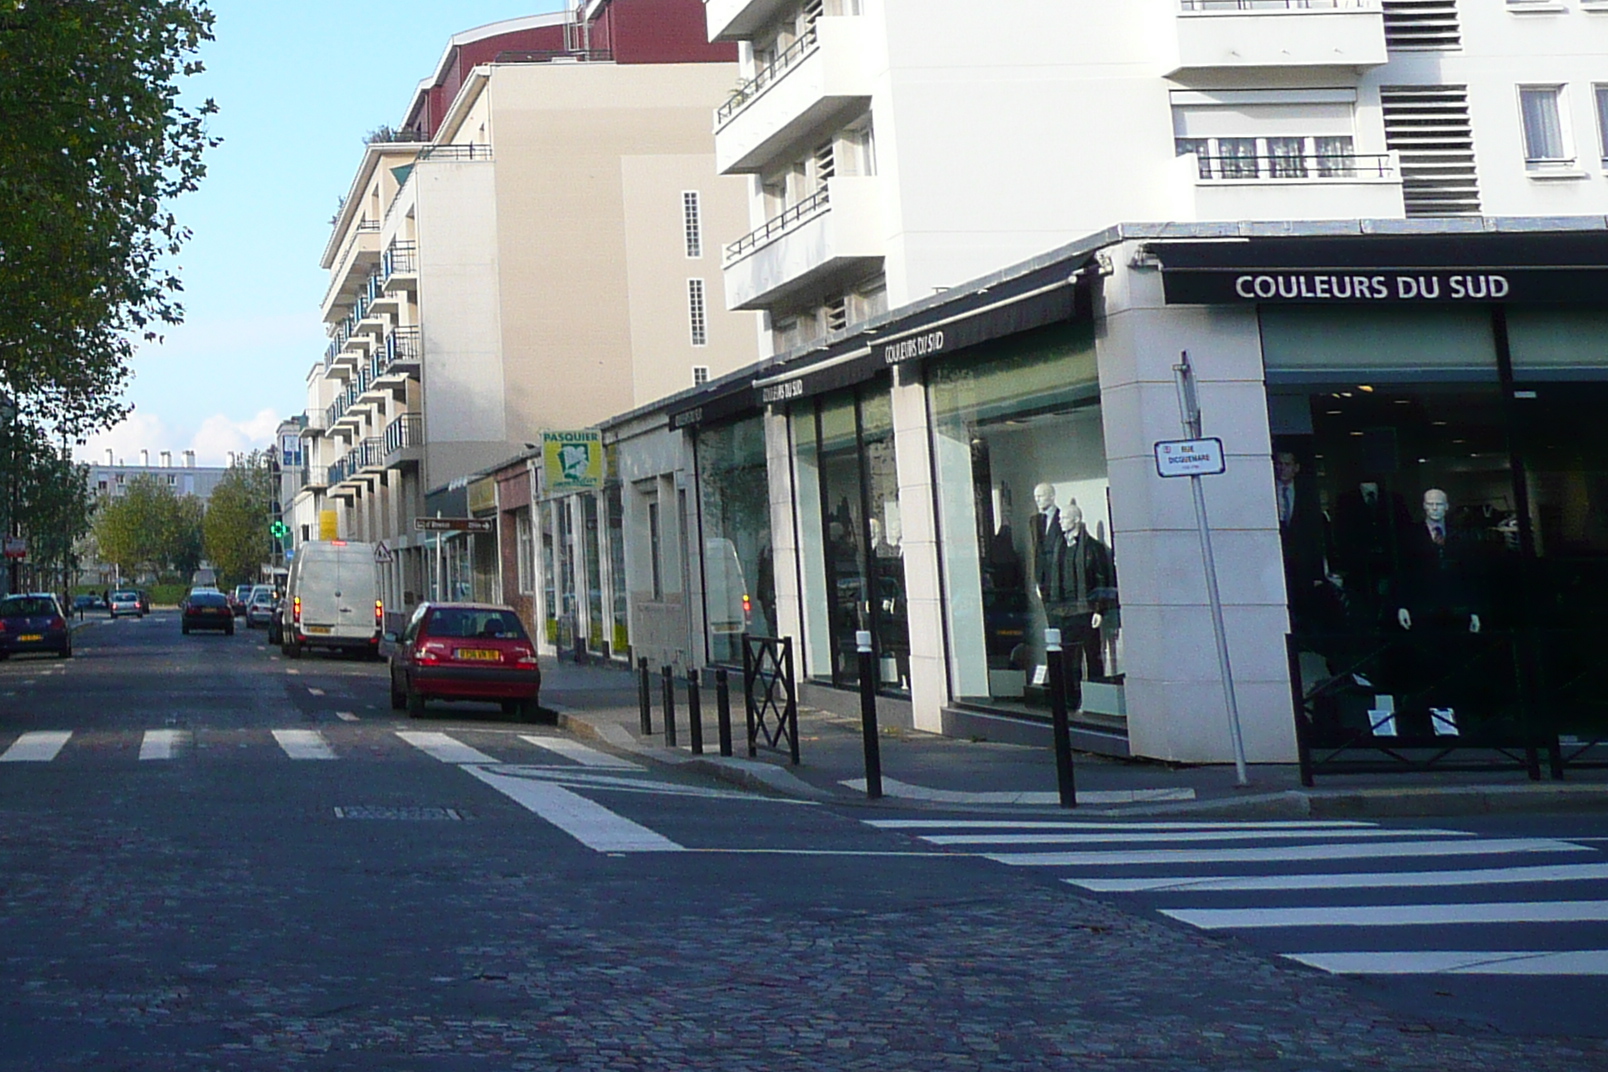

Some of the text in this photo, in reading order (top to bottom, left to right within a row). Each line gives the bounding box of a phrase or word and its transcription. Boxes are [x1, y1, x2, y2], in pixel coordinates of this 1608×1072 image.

[1235, 275, 1509, 299] COULEURS DU SUD
[885, 331, 944, 364] COULEURS DU SUD
[544, 432, 598, 442] PASQUIER
